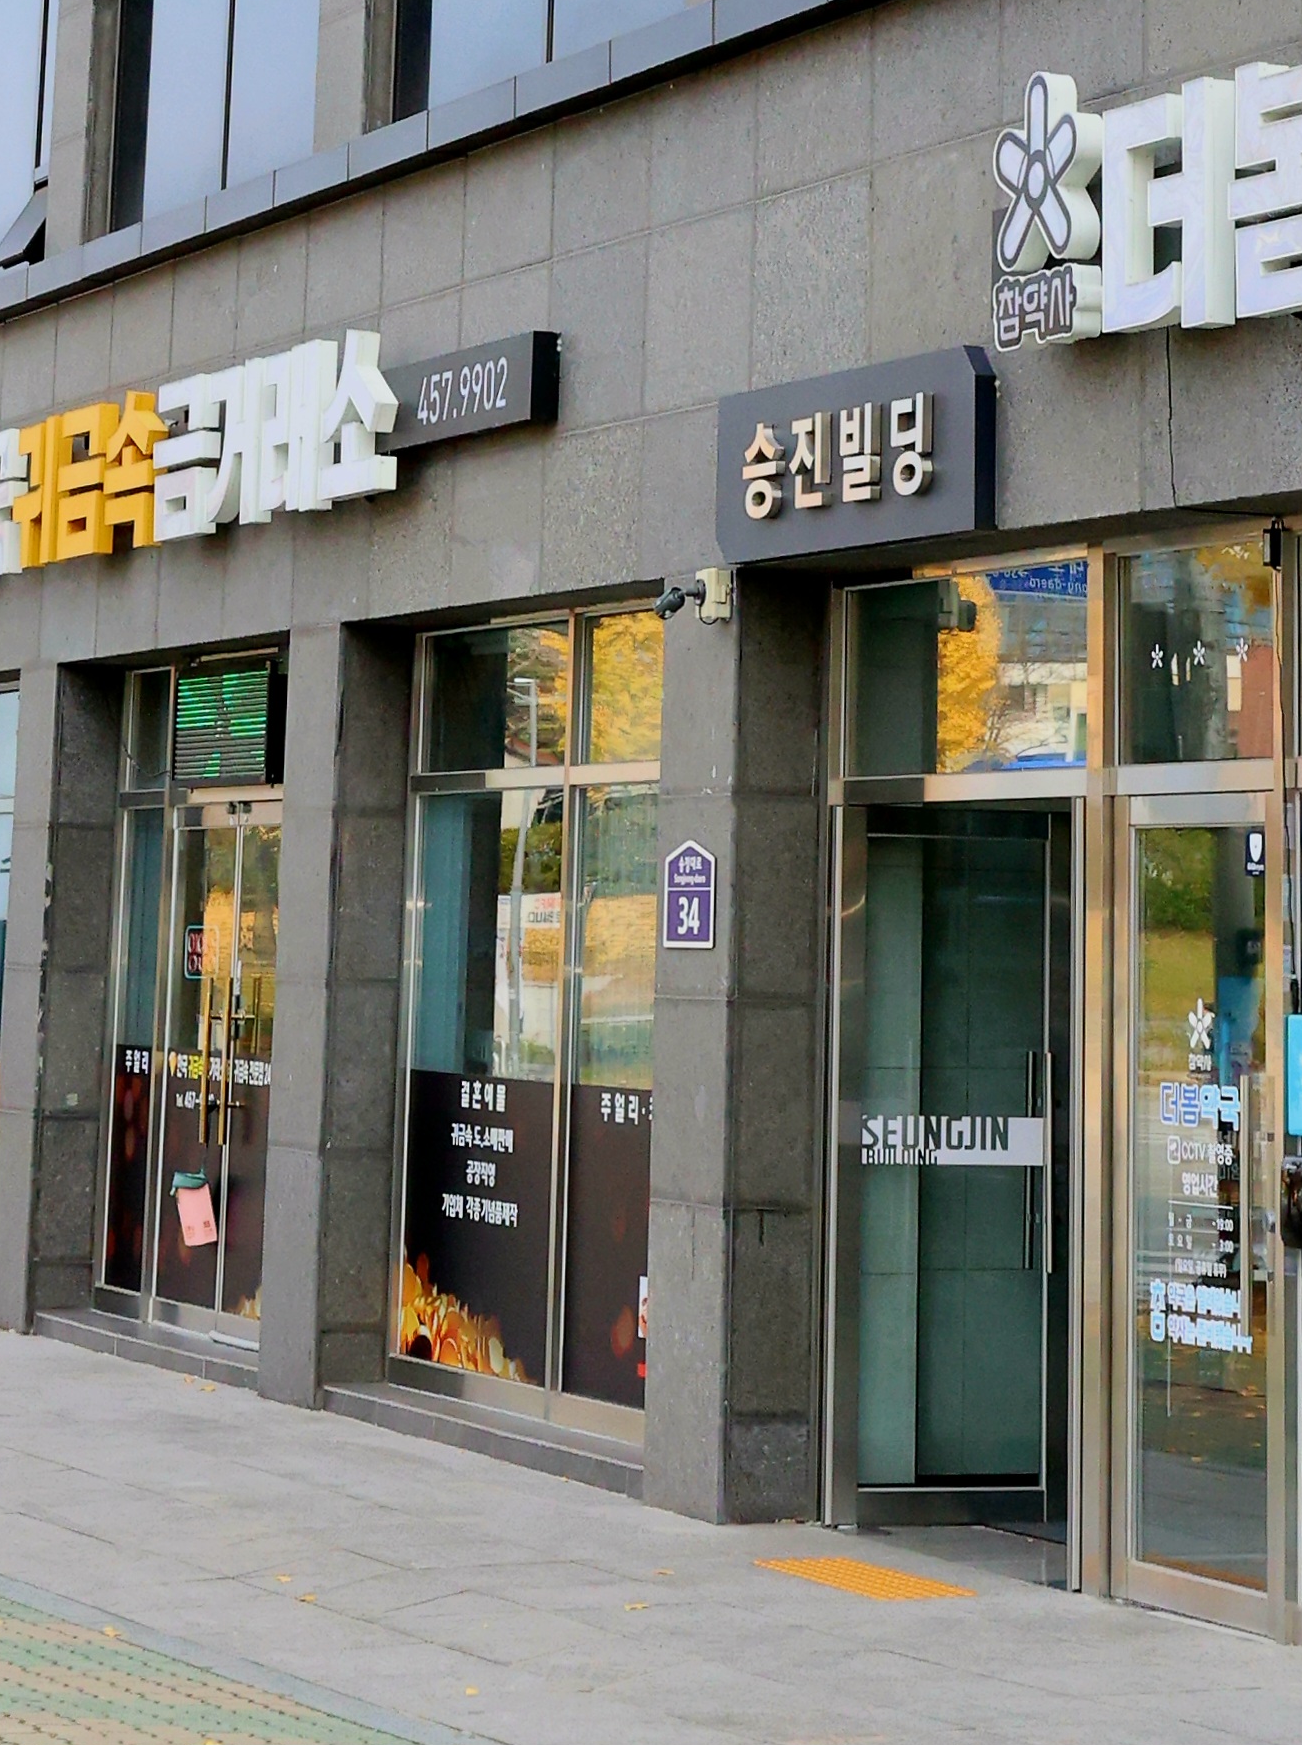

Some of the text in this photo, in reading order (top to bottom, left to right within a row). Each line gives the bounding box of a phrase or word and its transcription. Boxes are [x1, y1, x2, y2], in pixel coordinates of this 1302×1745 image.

[998, 273, 1074, 341] 참약사
[417, 357, 508, 426] 457.9902
[741, 391, 935, 520] 승진빌딩
[677, 896, 701, 936] 34
[125, 1049, 150, 1074] 주얼리
[461, 1080, 507, 1113] 결혼예물
[1160, 1082, 1241, 1131] 더봄약국
[451, 1122, 473, 1147] 귀금속
[862, 1115, 1009, 1151] SEUNGJIN
[862, 1148, 938, 1166] BUILDING
[1181, 1141, 1234, 1166] CCTV 촬영중
[466, 1159, 496, 1187] 공장직영
[1182, 1172, 1219, 1198] 영업시간
